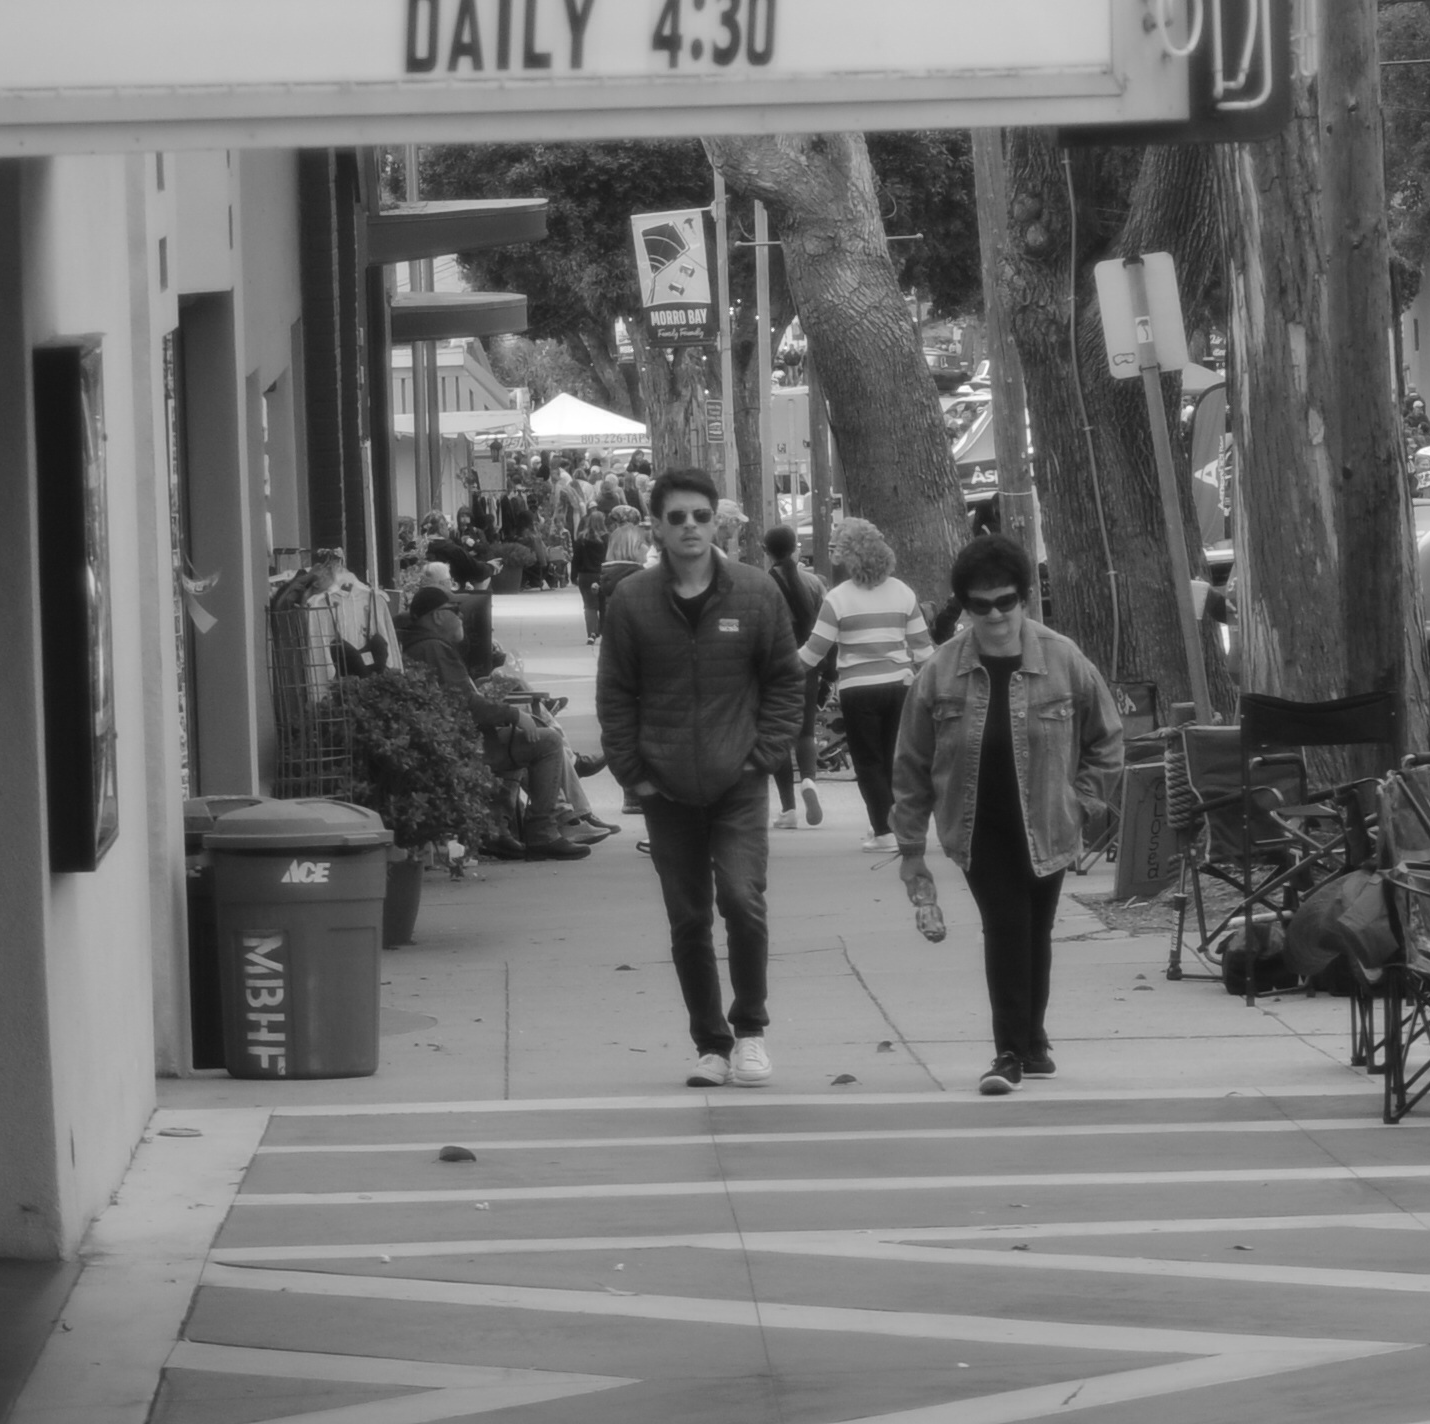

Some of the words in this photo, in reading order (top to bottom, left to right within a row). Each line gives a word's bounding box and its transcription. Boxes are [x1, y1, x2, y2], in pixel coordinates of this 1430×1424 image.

[650, 309, 687, 326] MORRO
[687, 307, 708, 324] BAY
[280, 859, 331, 884] ACE
[242, 935, 287, 1076] MBHF
